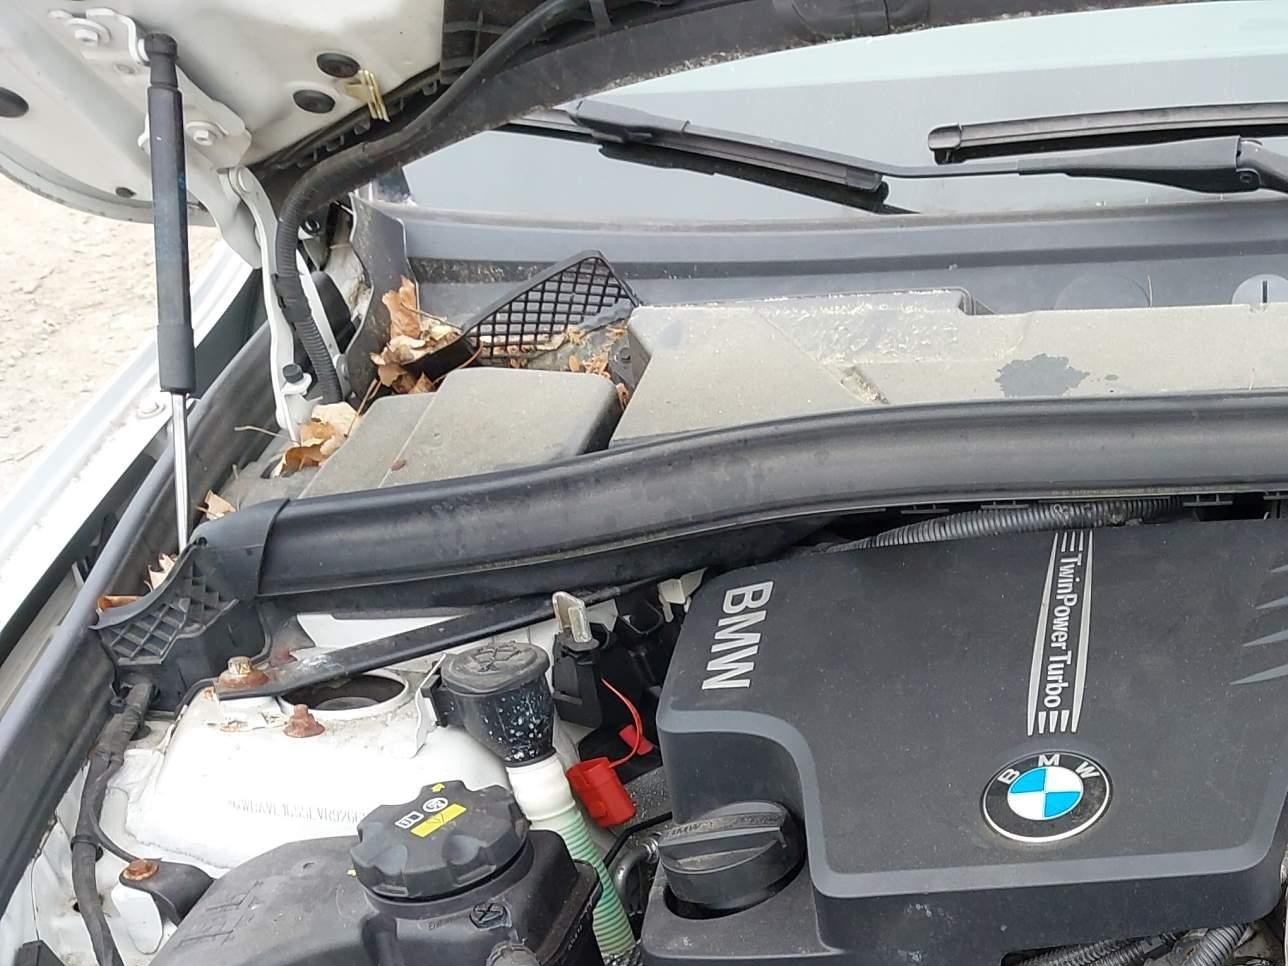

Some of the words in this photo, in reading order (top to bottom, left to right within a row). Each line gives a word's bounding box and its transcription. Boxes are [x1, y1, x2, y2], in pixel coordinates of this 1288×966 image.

[702, 581, 774, 690] BMW
[1051, 553, 1082, 650] TwinPower
[1044, 650, 1072, 708] Turbo
[997, 753, 1101, 785] BMW
